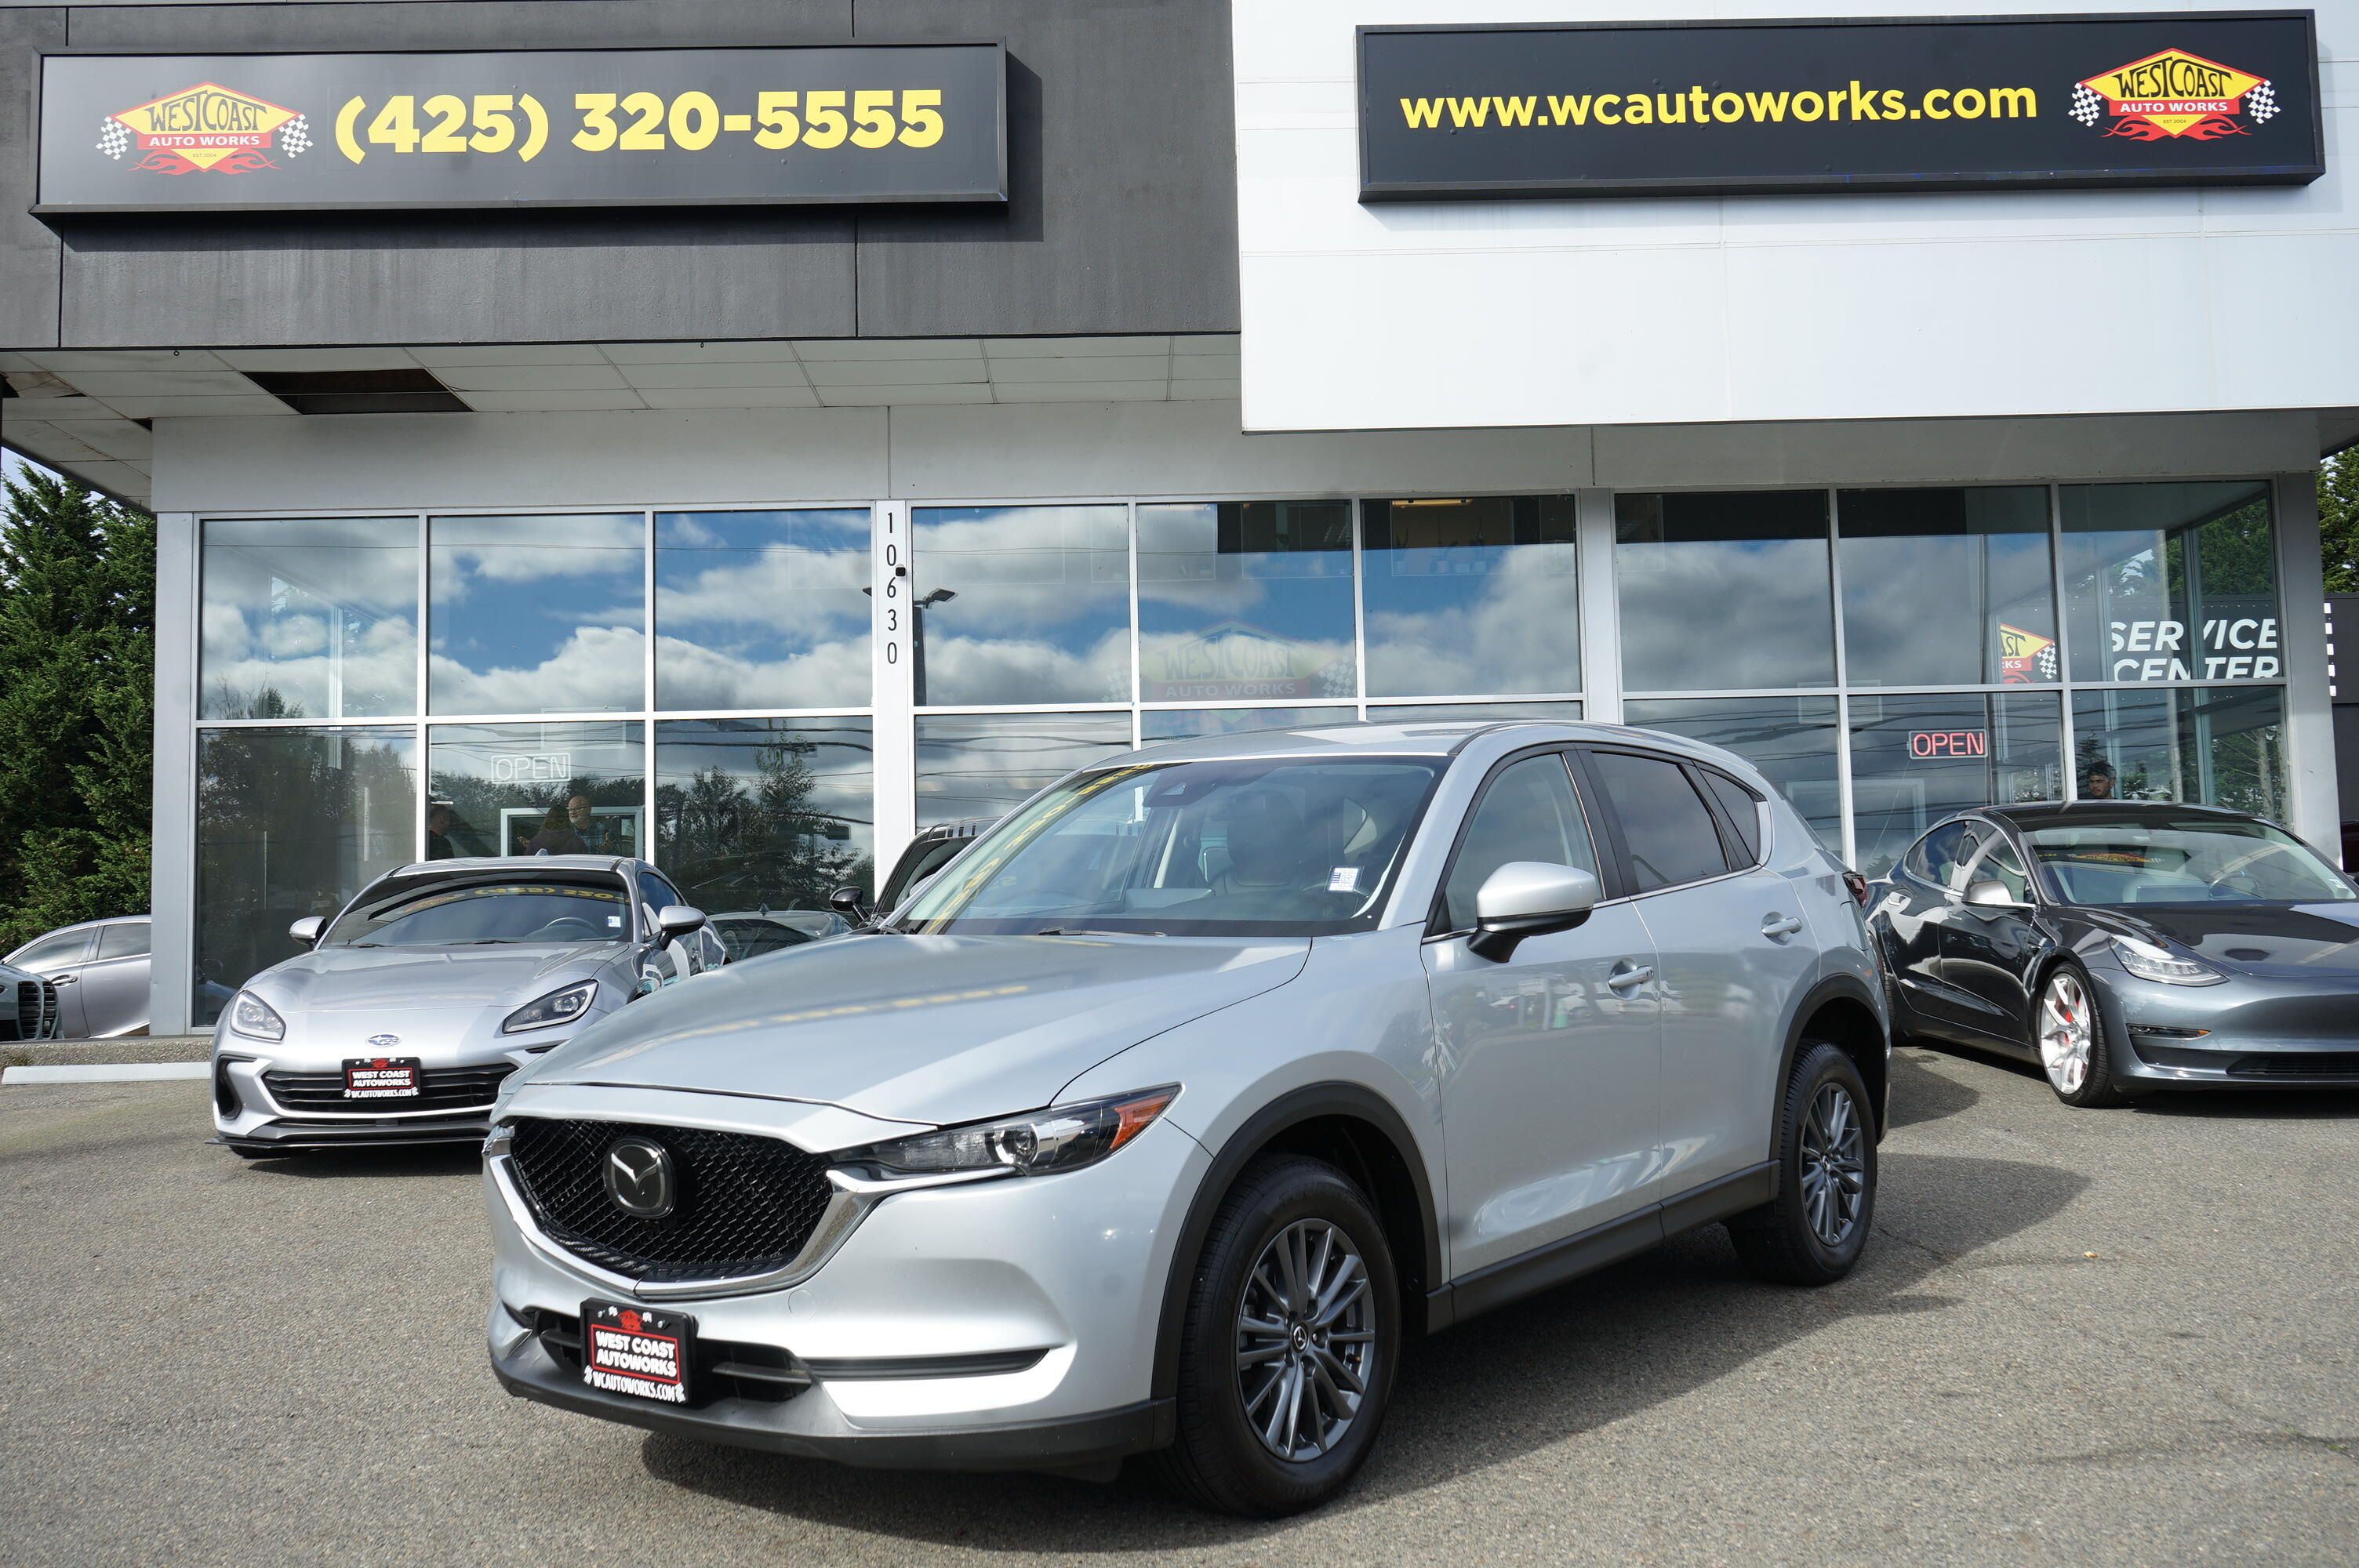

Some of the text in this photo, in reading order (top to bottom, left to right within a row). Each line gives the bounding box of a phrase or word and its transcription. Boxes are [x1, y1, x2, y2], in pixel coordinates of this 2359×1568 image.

[1400, 81, 2037, 129] www.wcautoworks.com
[2120, 102, 2228, 113] AUTO WORKS
[335, 89, 944, 165] (425) 320-5555
[149, 136, 260, 147] AUTO WORKS
[1165, 683, 1296, 698] AUTO WORKS
[1914, 732, 1983, 756] OPEN
[496, 756, 567, 781] OPEN
[379, 1070, 410, 1079] COAST
[595, 1331, 675, 1359] WEST COAST
[596, 1349, 677, 1377] AUTOWORKS
[592, 1371, 675, 1402] WCAUTOWORKS.COM
